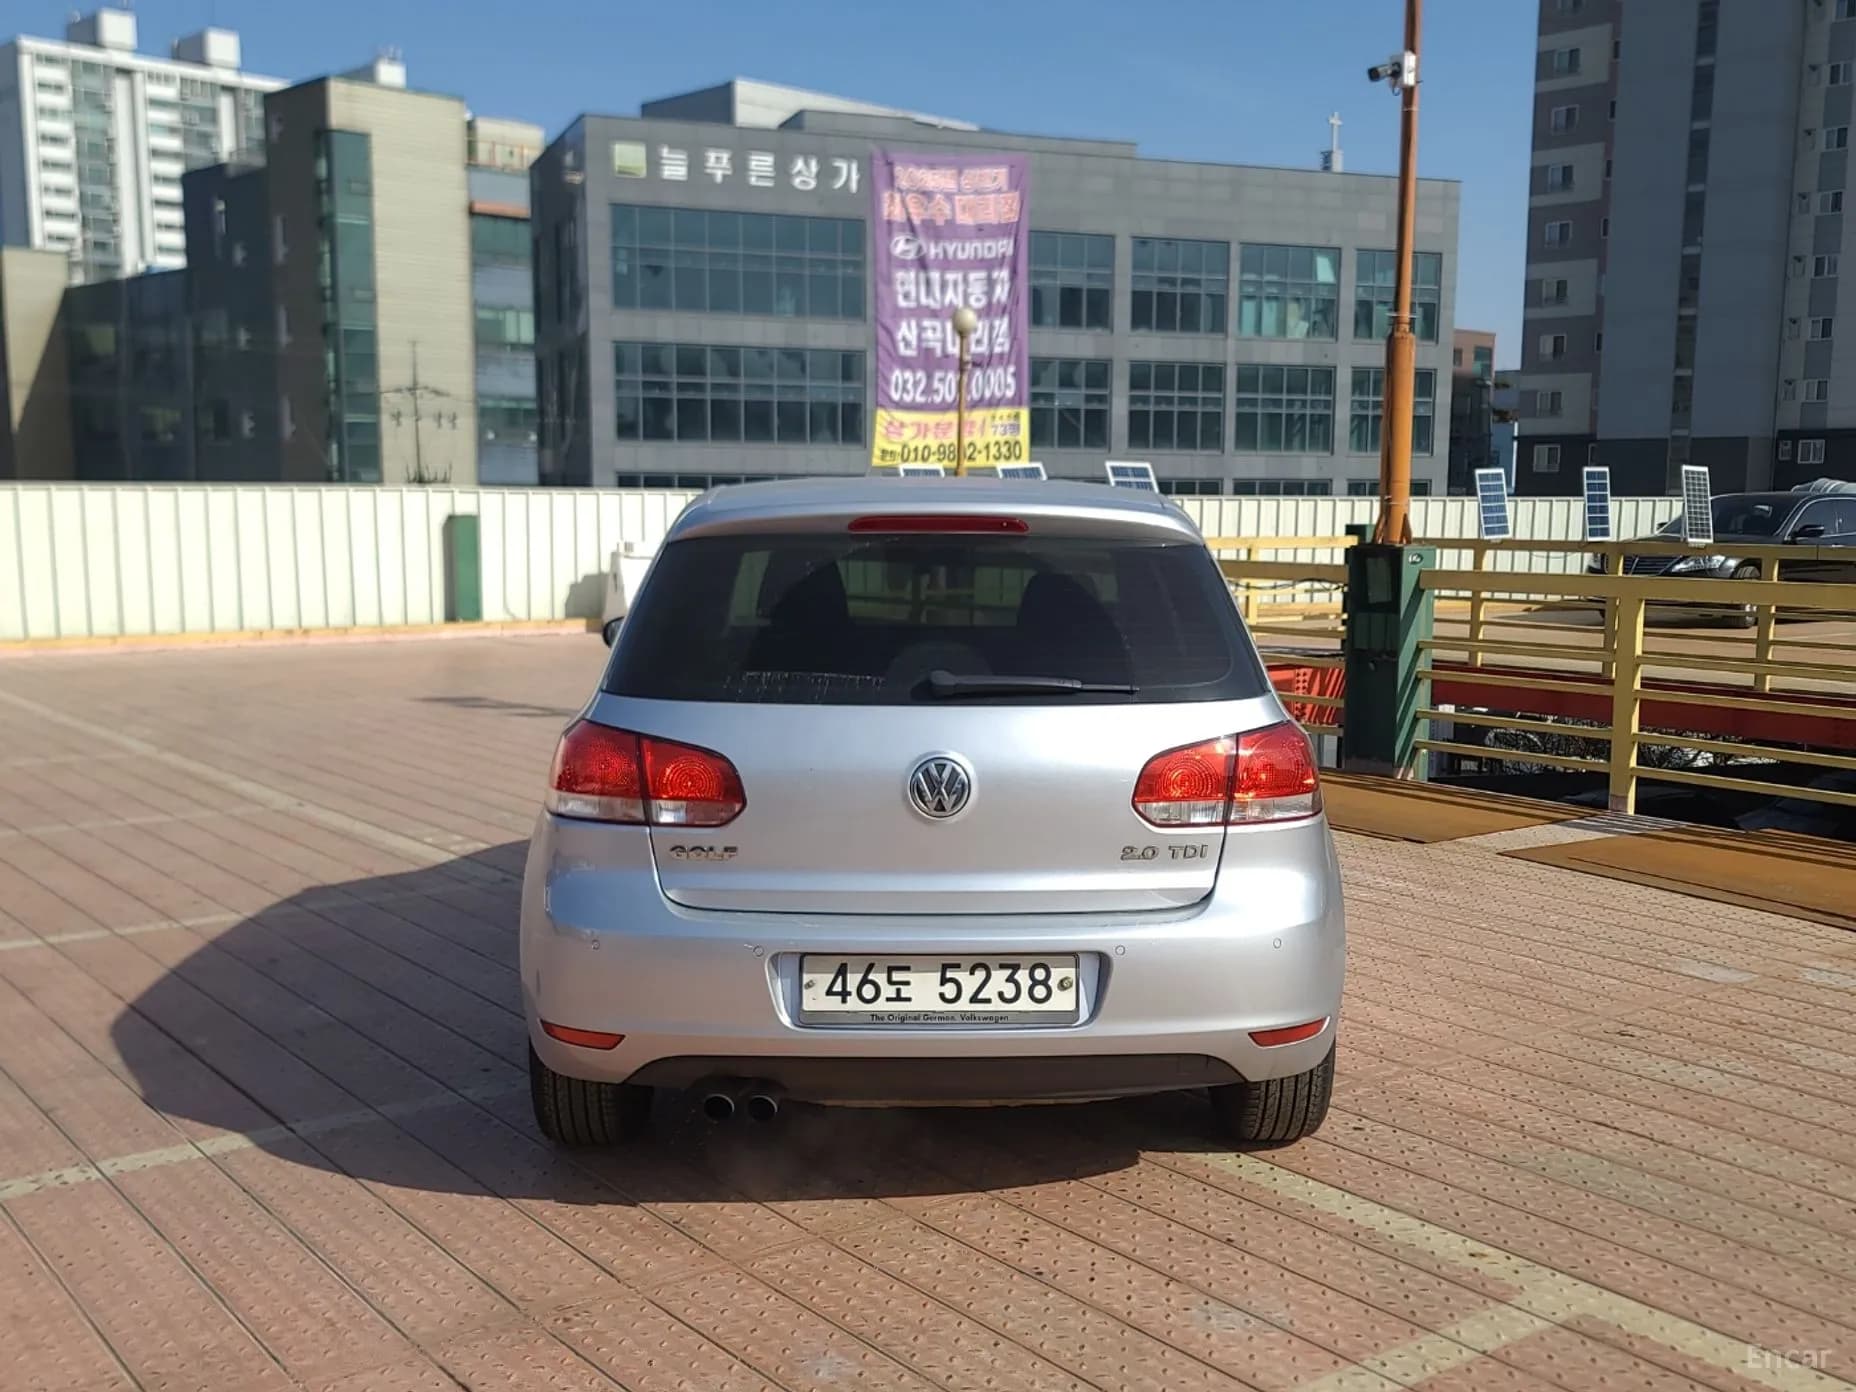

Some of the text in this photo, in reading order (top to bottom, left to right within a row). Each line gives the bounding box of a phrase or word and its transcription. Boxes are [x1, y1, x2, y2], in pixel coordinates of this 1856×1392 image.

[659, 145, 860, 193] 늘푸른상가
[890, 366, 1017, 403] 032.50.0005
[901, 441, 1022, 464] 010-982-1330
[670, 845, 738, 861] GOLF
[1120, 844, 1208, 861] 2.0 TDI
[825, 962, 1053, 1004] 46도 5238
[870, 1014, 885, 1022] The
[887, 1014, 919, 1023] Original
[960, 1014, 1009, 1023] Volkswagen
